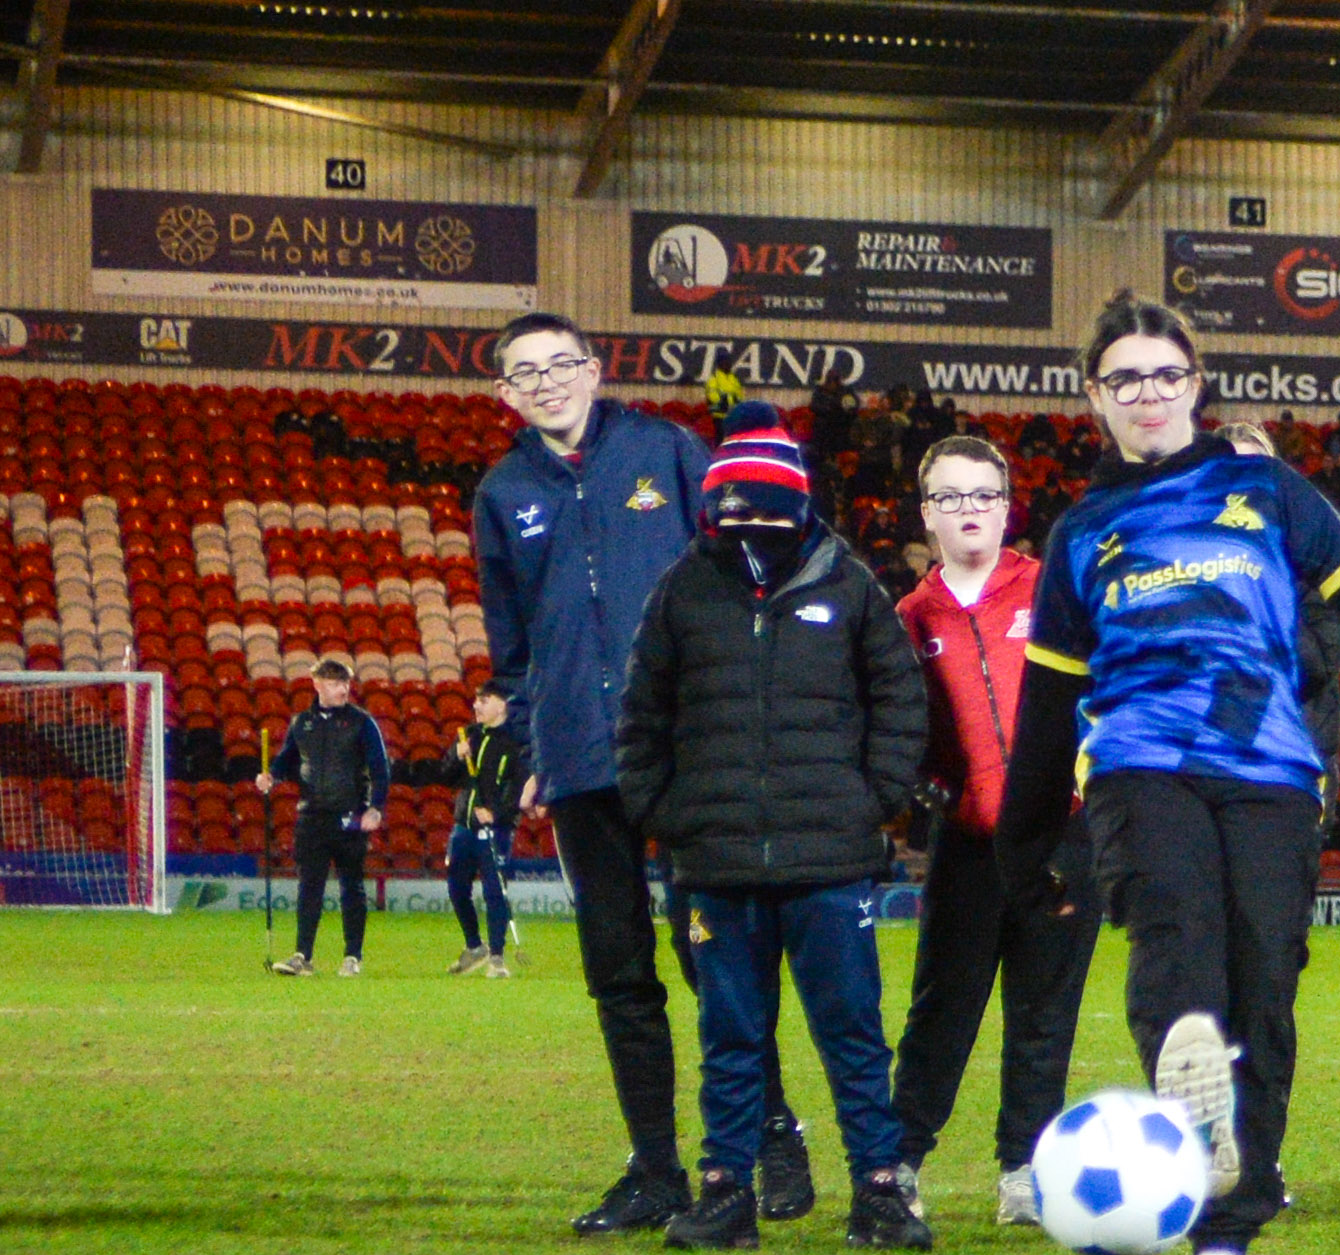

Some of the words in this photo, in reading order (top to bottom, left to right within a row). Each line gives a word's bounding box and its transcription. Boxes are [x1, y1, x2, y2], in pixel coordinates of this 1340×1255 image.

[329, 162, 362, 186] 40
[1233, 200, 1264, 223] 41
[229, 213, 404, 248] DANUM
[857, 231, 941, 253] REPAIR
[261, 246, 373, 267] HOMES
[733, 243, 829, 277] MK2
[855, 251, 1036, 276] MAINTENANCE
[30, 322, 85, 342] MK2
[140, 318, 193, 351] CAT
[264, 324, 400, 372] MK2
[1123, 553, 1263, 598] PassLogistics
